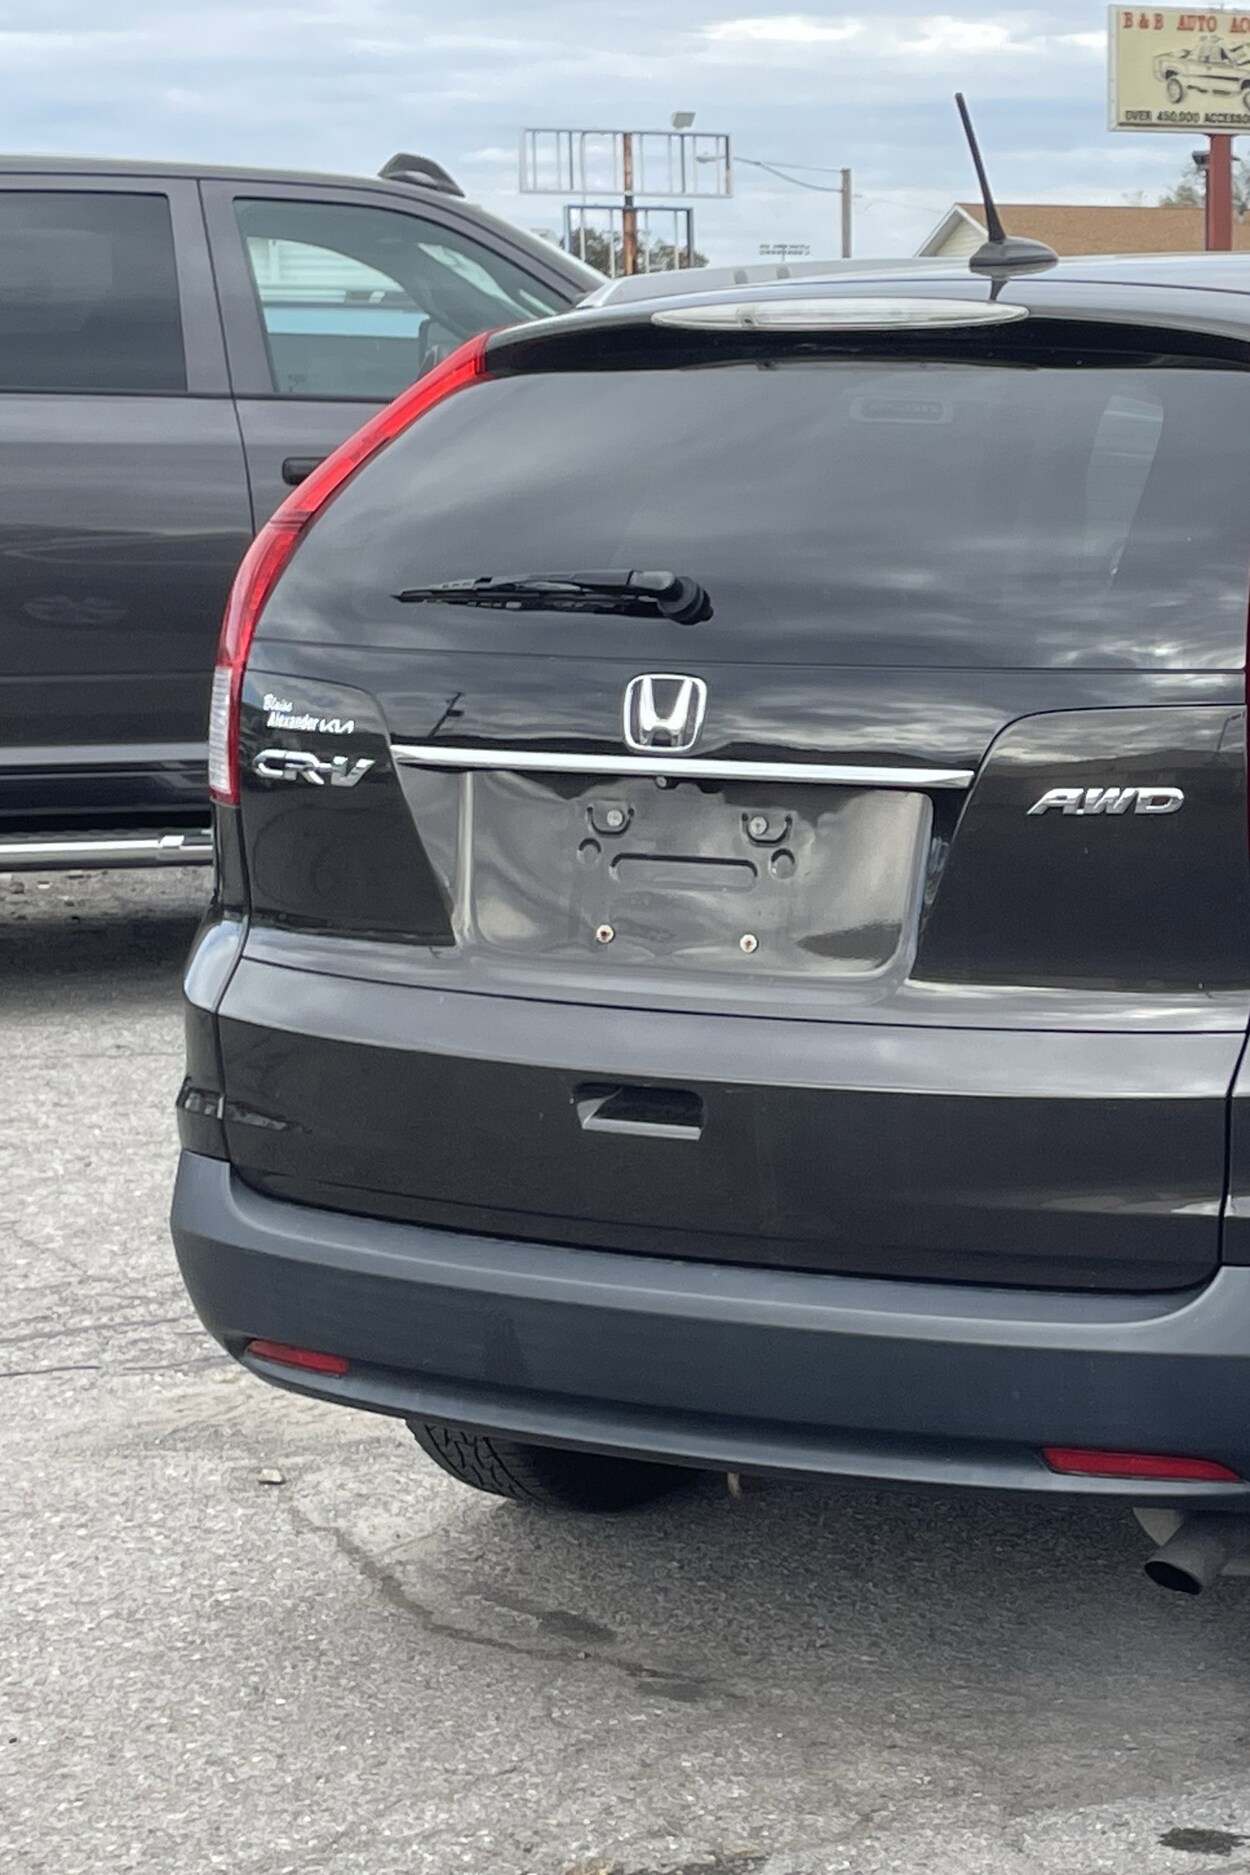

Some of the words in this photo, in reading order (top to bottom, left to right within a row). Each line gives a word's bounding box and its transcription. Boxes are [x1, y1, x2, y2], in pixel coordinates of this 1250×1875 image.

[1122, 11, 1133, 29] B
[1138, 12, 1149, 29] &
[1153, 13, 1164, 30] B
[1176, 14, 1218, 33] AUTO
[1125, 110, 1152, 121] OVER
[267, 711, 320, 731] Alexander
[319, 718, 355, 735] KIA
[252, 748, 376, 787] CR-V
[1026, 786, 1185, 815] AWD
